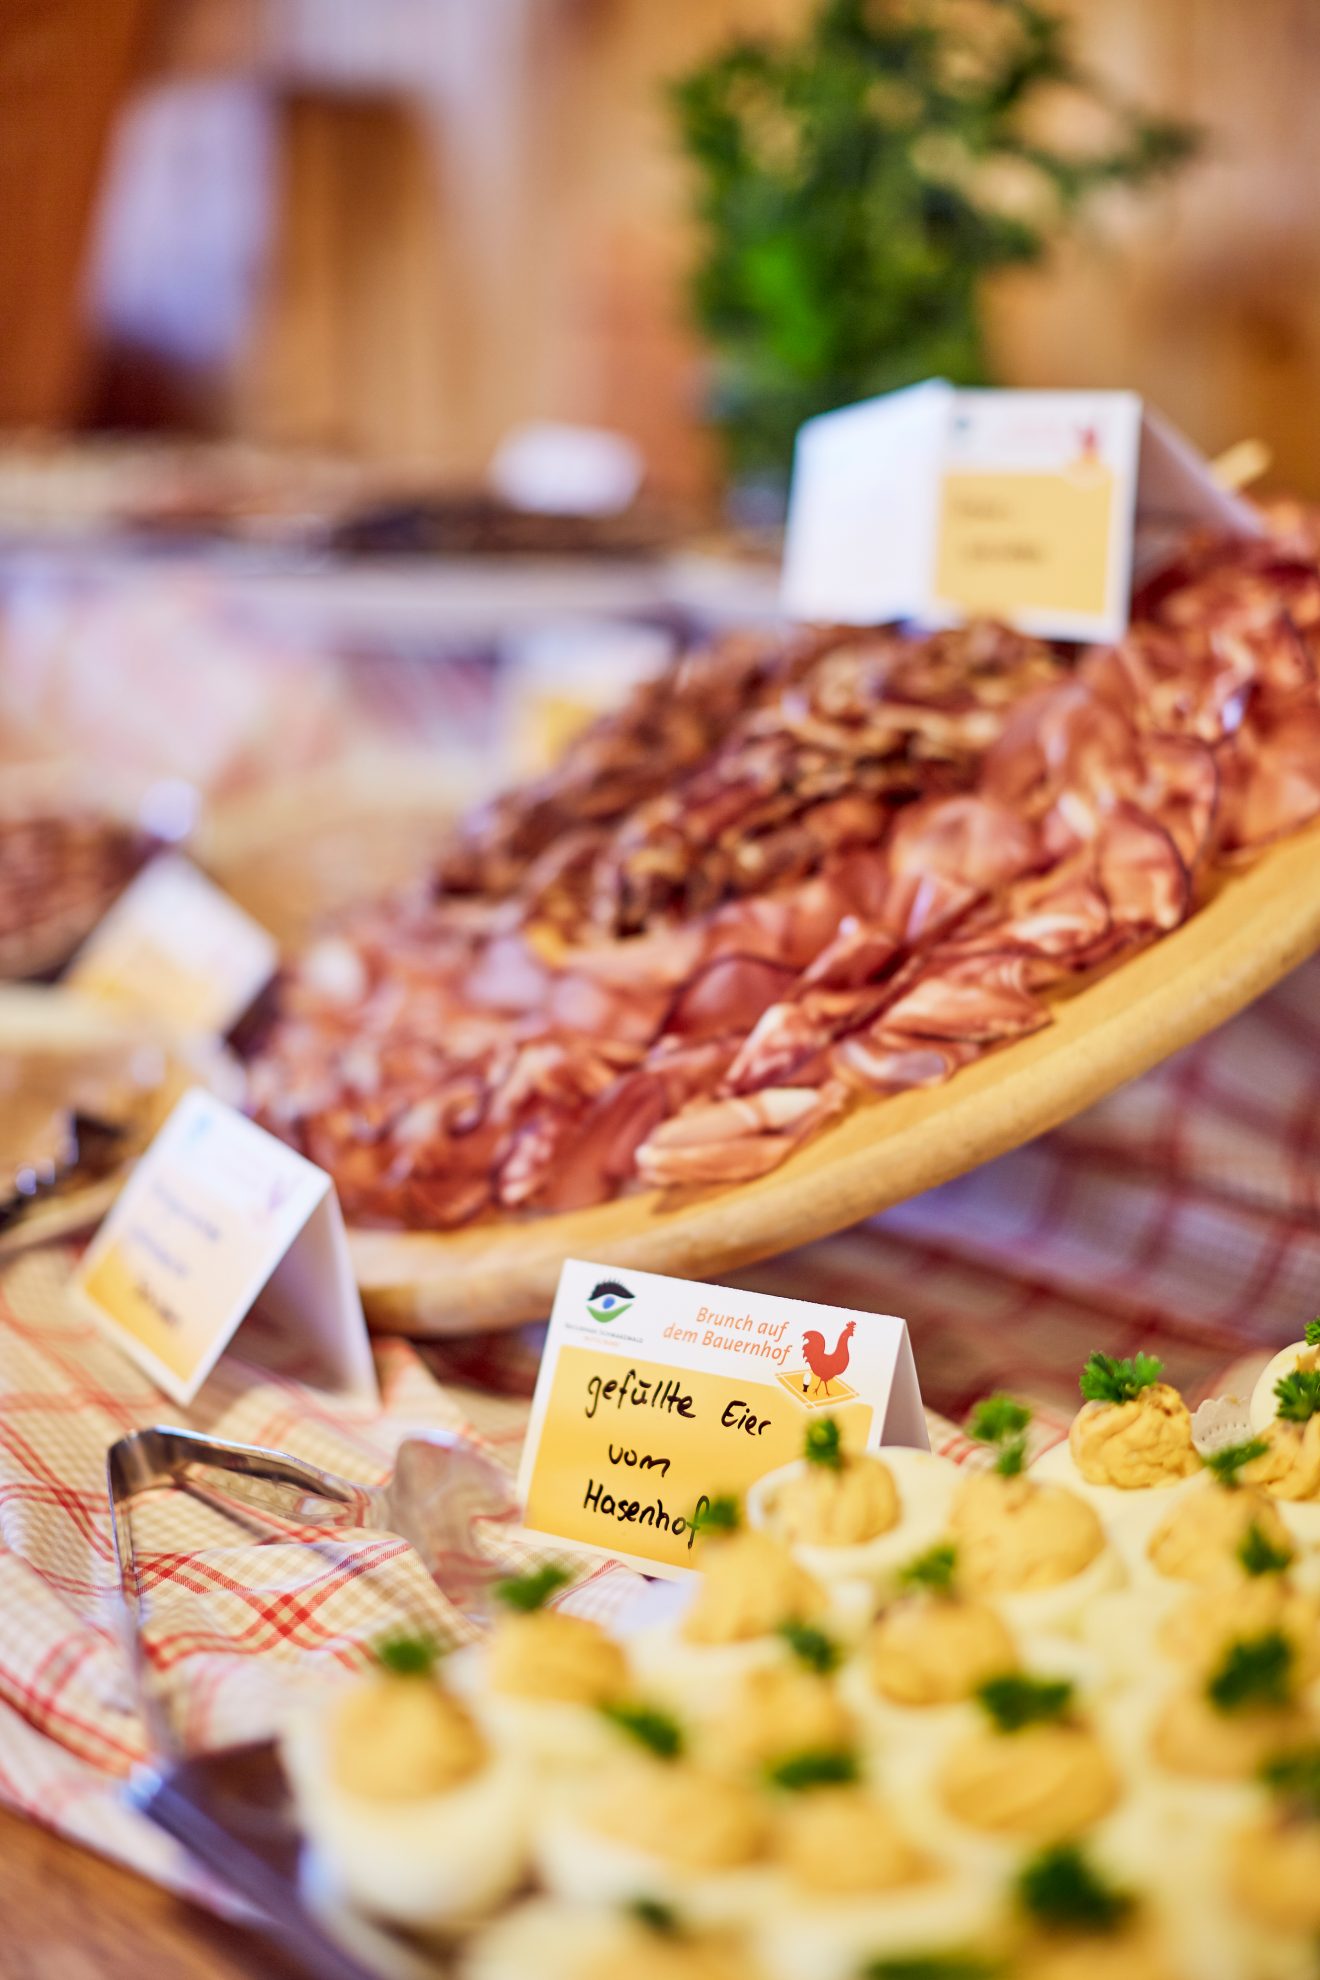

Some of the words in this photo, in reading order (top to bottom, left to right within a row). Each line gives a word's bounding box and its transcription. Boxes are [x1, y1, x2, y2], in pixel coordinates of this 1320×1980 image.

[663, 1323, 698, 1344] dem
[702, 1331, 793, 1366] Bauernhof
[696, 1307, 754, 1332] Brunch
[757, 1321, 790, 1342] auf
[585, 1369, 696, 1418] gefüllte
[721, 1400, 771, 1436] Eier
[608, 1444, 671, 1478] vom
[583, 1479, 710, 1549] Hasenhof
